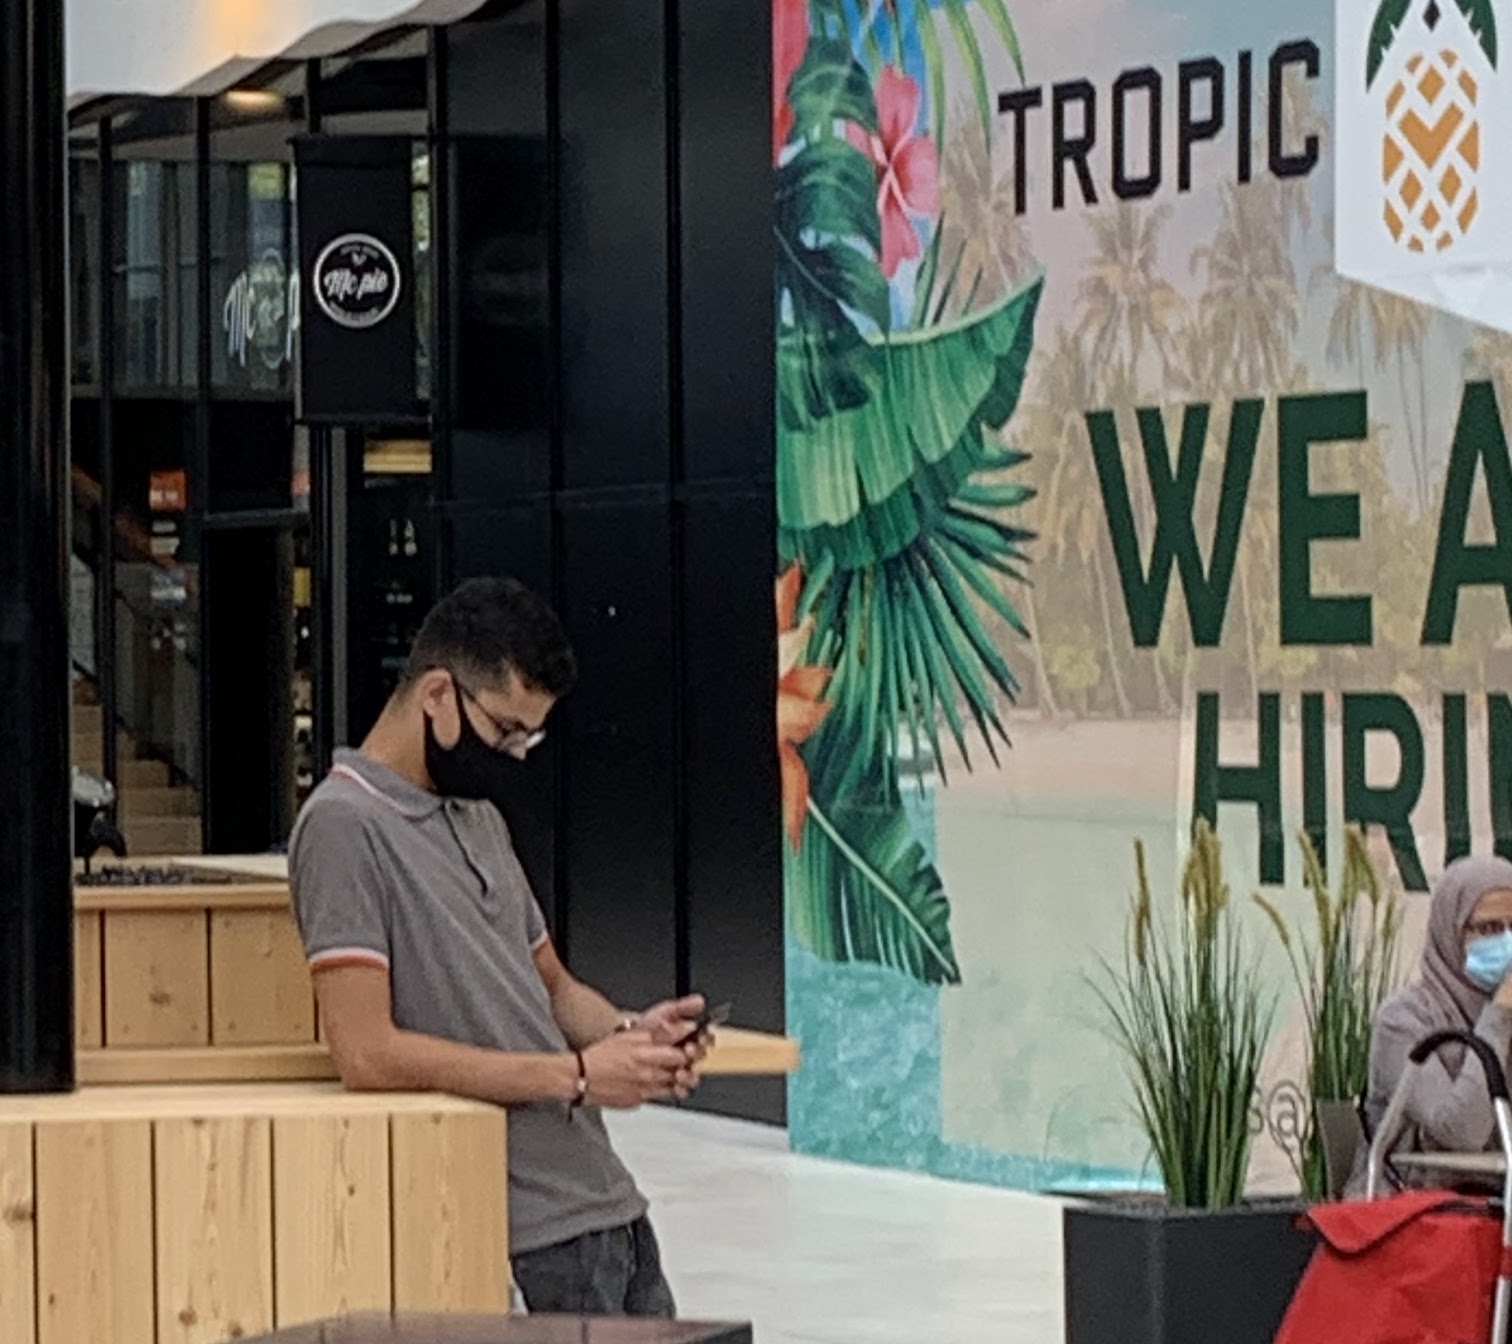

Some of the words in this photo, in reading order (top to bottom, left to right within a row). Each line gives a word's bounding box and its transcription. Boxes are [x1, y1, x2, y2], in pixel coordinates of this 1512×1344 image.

[998, 38, 1320, 215] TROPIC
[1085, 390, 1373, 647] WE
[1192, 692, 1512, 891] HIRI
